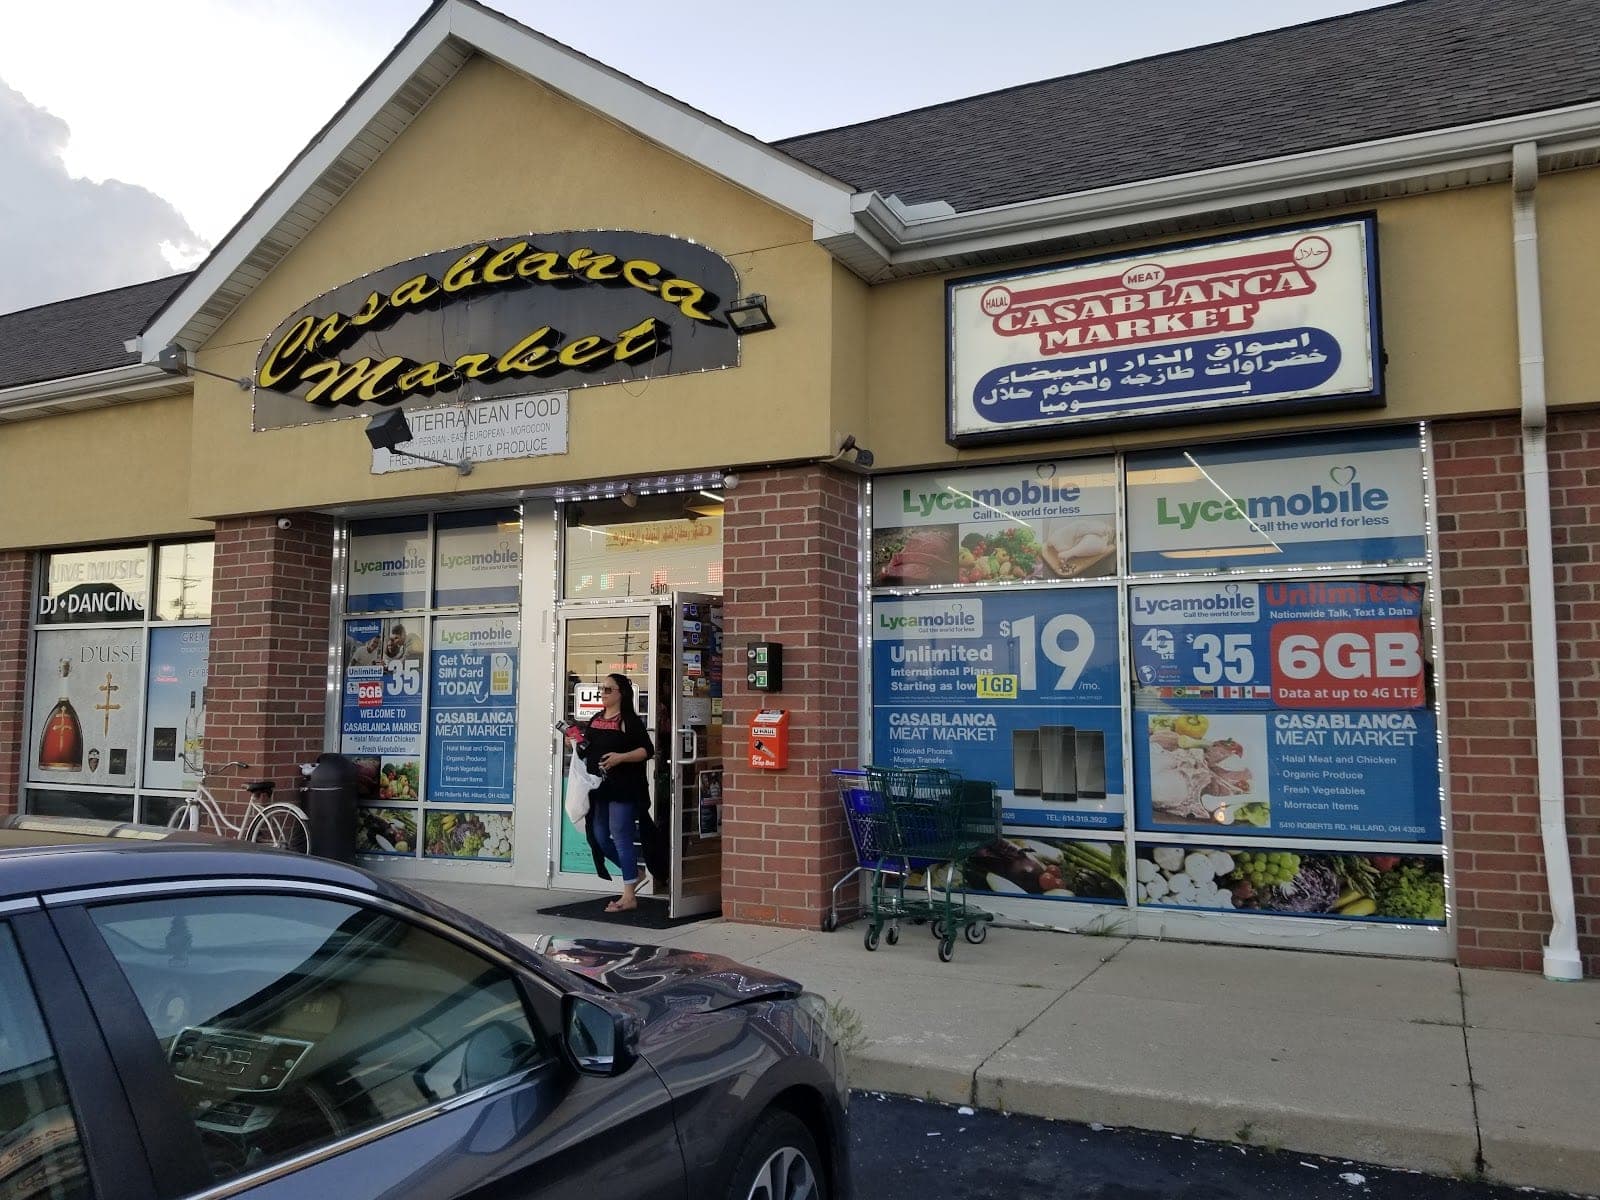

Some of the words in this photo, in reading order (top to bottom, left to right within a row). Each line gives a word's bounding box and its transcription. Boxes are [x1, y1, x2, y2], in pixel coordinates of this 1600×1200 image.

[1127, 270, 1161, 285] MEAT
[985, 294, 1009, 309] HALAL
[998, 272, 1308, 330] CASABLANCA
[1045, 303, 1254, 350] MARKET
[1206, 332, 1311, 361] اسواق
[301, 317, 657, 402] Market
[1116, 347, 1194, 371] الدار
[1205, 349, 1328, 376] خضراوات
[996, 358, 1108, 385] البيضاء
[1042, 376, 1112, 399] ولحوم
[981, 387, 1033, 405] حلال
[515, 397, 561, 419] FOOD
[457, 444, 484, 460] MEAT
[487, 445, 493, 457] &
[497, 438, 547, 455] PRODUCE
[903, 480, 1080, 517] Lycamobile
[1157, 482, 1389, 530] Lycamobile
[973, 510, 992, 520] Call
[1012, 507, 1040, 517] world
[1043, 506, 1059, 515] for
[1060, 506, 1080, 514] less
[1250, 521, 1274, 533] Call
[1276, 520, 1298, 531] the
[1301, 518, 1338, 530] world
[1341, 517, 1360, 527] for
[1362, 516, 1389, 526] less
[353, 556, 426, 575] Lycamobile
[440, 549, 518, 569] Lycamobile
[87, 559, 145, 580] MUSIC
[1135, 593, 1255, 615] Lycamobile
[880, 611, 975, 630] Lycamobile
[1270, 610, 1325, 619] Nationwide
[1328, 608, 1351, 618] Talk,
[1354, 607, 1375, 617] Text
[1378, 607, 1385, 616] &
[1388, 607, 1412, 616] Data
[441, 627, 512, 644] Lycamobile
[439, 654, 458, 666] Get
[460, 653, 484, 665] Your
[890, 644, 992, 662] Unlimited
[1278, 632, 1422, 680] 6GB
[348, 667, 382, 676] Unlimited
[387, 659, 420, 695] 35
[438, 668, 457, 679] SIM
[459, 667, 484, 678] Card
[891, 667, 959, 677] International
[963, 667, 993, 676] Plans
[359, 686, 383, 698] 6GB
[438, 681, 483, 695] TODAY
[891, 681, 936, 692] Starting
[940, 683, 952, 691] as
[956, 680, 977, 691] low
[1079, 681, 1101, 690] /mo.
[1279, 688, 1311, 699] Data
[1314, 688, 1327, 698] at
[1332, 689, 1349, 701] up
[1353, 689, 1368, 698] to
[1372, 688, 1389, 698] 4G
[1394, 687, 1418, 698] LTE
[360, 709, 396, 718] WELCOME
[396, 708, 406, 718] TO
[435, 712, 514, 724] CASABLANCA
[889, 713, 996, 726] CASABLANCA
[344, 722, 390, 732] CASABLANCA
[392, 722, 421, 732] MARKET
[1275, 714, 1417, 729] CASABLANCA
[435, 725, 465, 736] MEAT
[467, 725, 514, 737] MARKET
[890, 727, 928, 740] MEAT
[933, 727, 997, 741] MARKET
[1276, 731, 1327, 745] MEAT
[1334, 731, 1418, 746] MARKET
[926, 747, 953, 755] Phones
[893, 756, 916, 764] Money
[1282, 755, 1306, 763] Halal
[1309, 755, 1333, 763] Meat
[1336, 755, 1353, 764] and
[1356, 755, 1397, 765] Chicken
[1283, 771, 1320, 780] Organic
[1323, 771, 1363, 780] Produce
[1284, 785, 1310, 794] Fresh
[1312, 785, 1366, 796] Vegetables
[1332, 802, 1359, 811] Items
[1297, 822, 1333, 830] ROBERTS
[1389, 824, 1401, 833] OH
